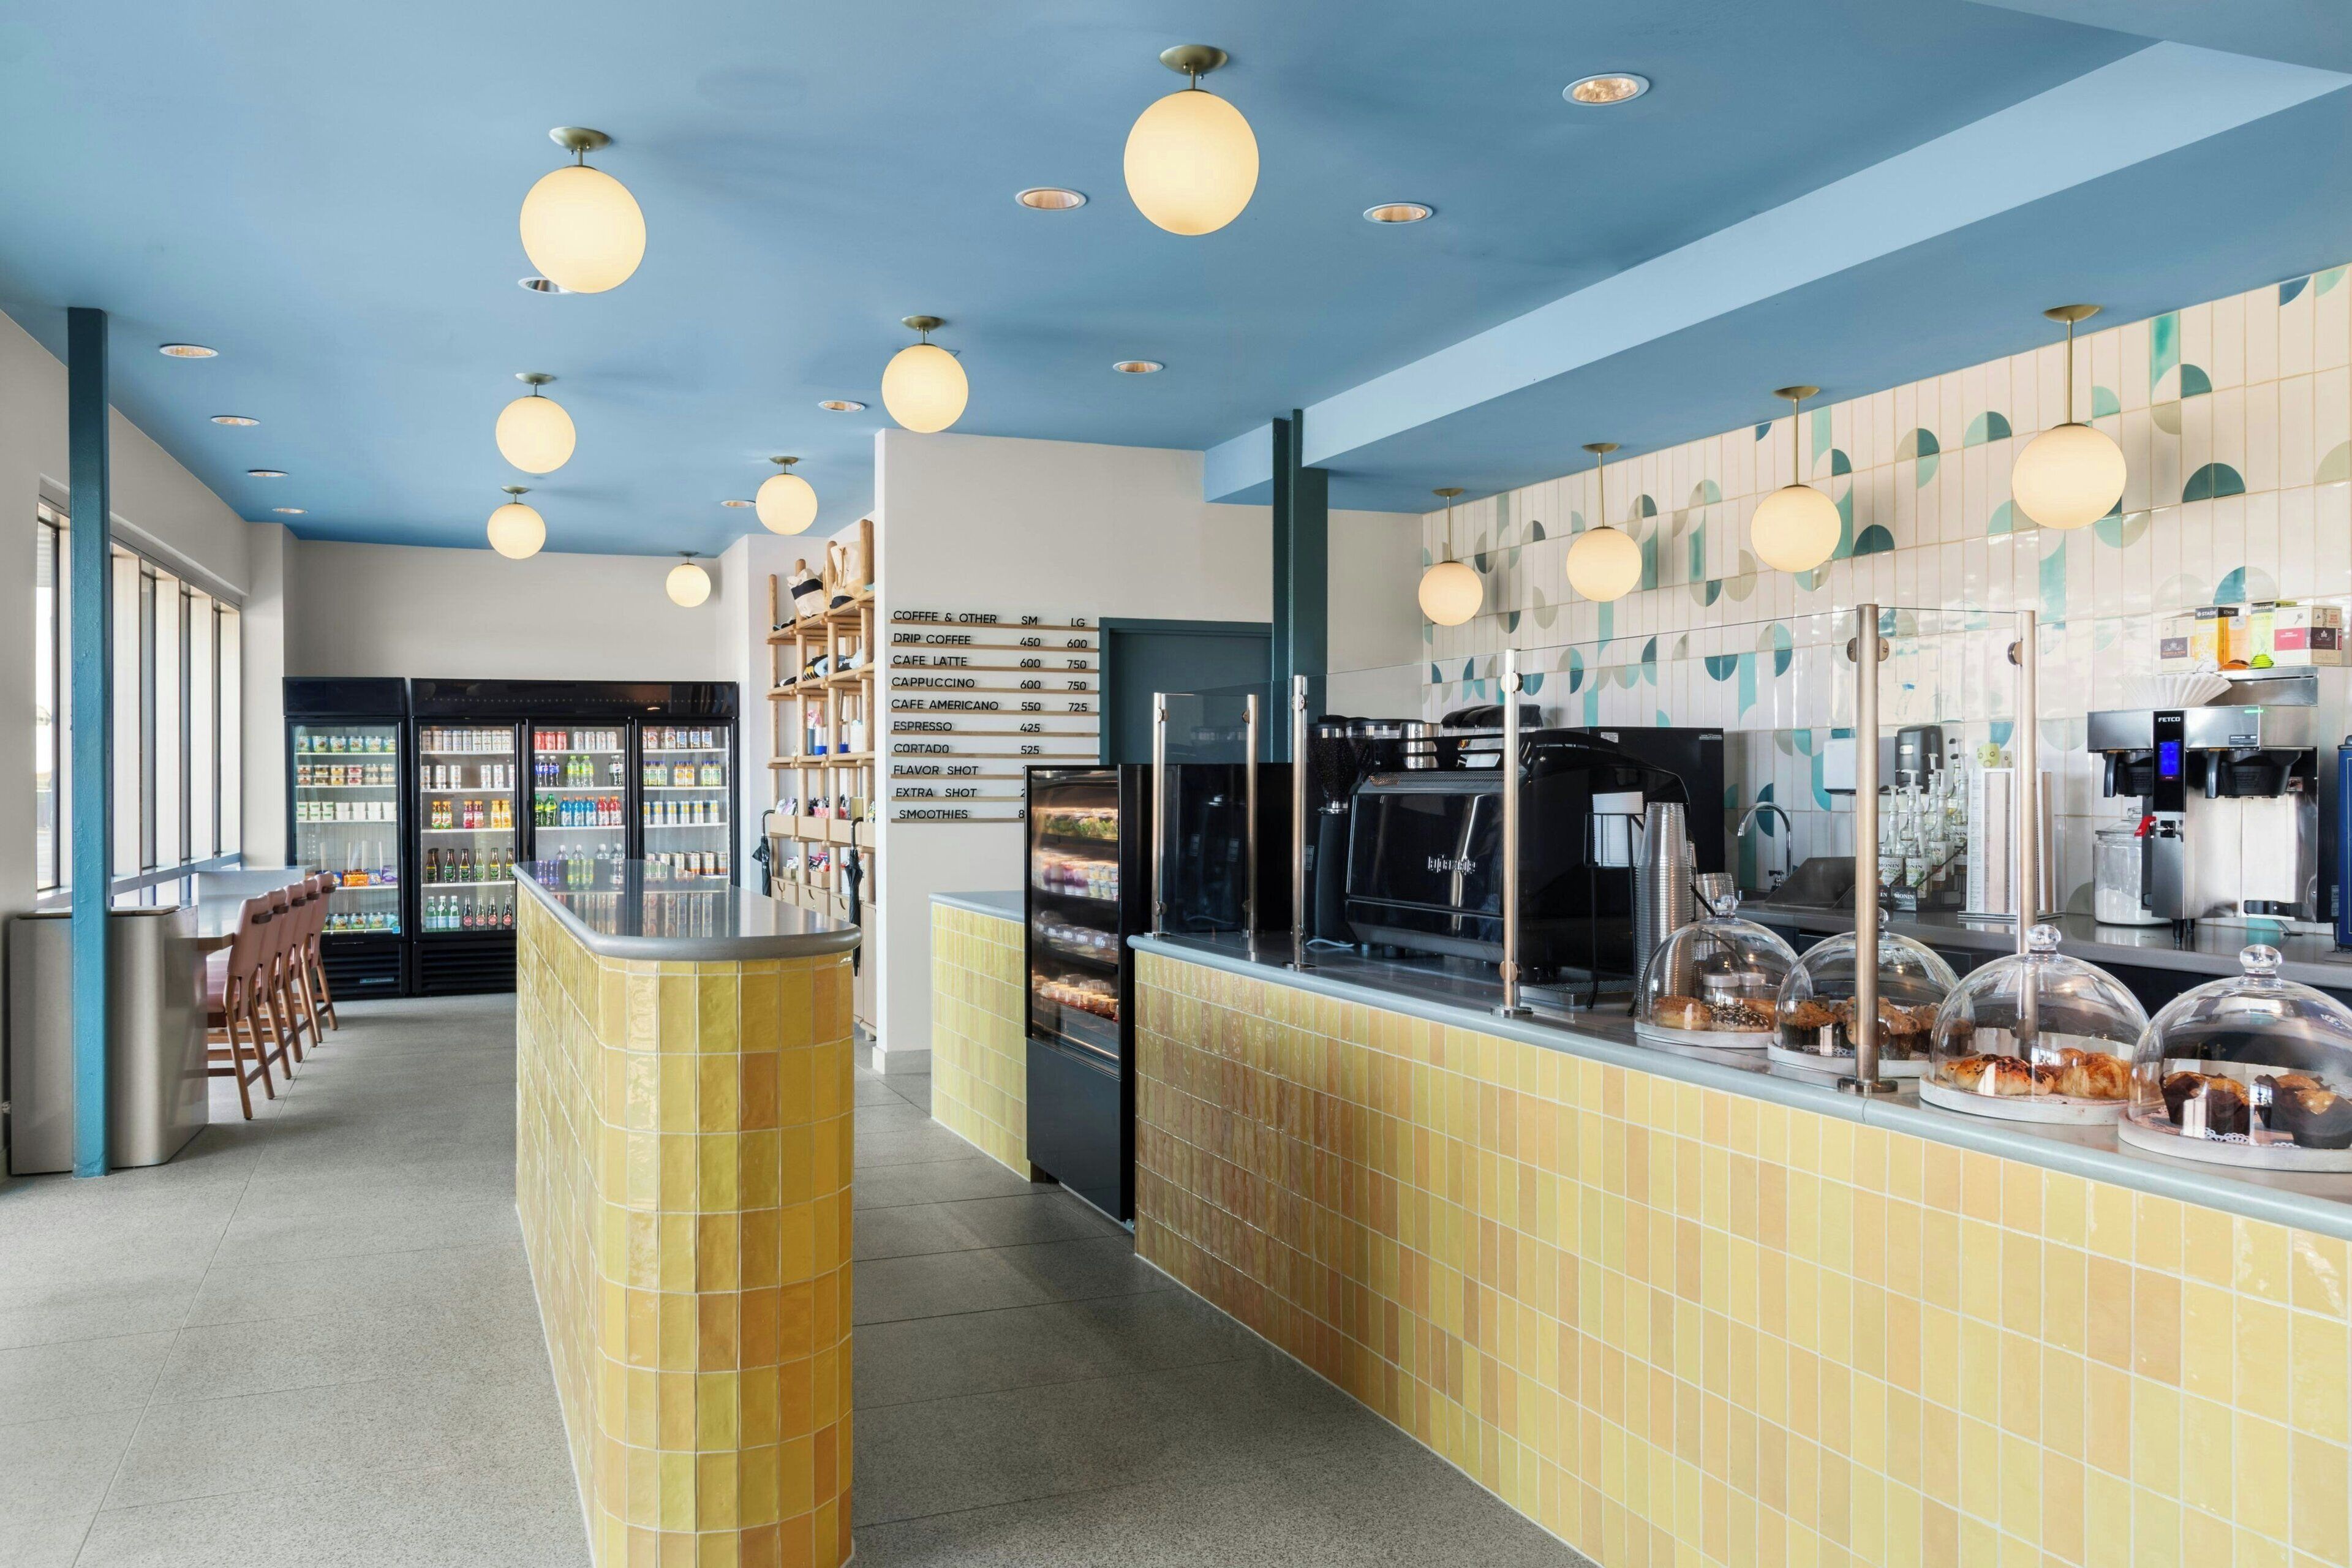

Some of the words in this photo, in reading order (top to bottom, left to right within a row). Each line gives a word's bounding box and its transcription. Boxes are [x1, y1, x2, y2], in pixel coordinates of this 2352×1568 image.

[893, 611, 938, 622] COFFFE
[944, 612, 952, 622] &
[959, 613, 997, 624] OTHER
[1021, 616, 1038, 625] SM
[1071, 618, 1085, 627] LG
[894, 633, 921, 643] DRIP
[926, 635, 971, 645] COFFEE
[1020, 637, 1041, 647] 450
[1067, 639, 1088, 649] 600
[893, 655, 925, 665] CAFE
[933, 656, 967, 666] LATTE
[1020, 658, 1041, 668] 600
[1067, 660, 1087, 669] 750
[892, 677, 975, 688] CAPPUCCINO
[1020, 680, 1041, 690] 600
[1068, 681, 1087, 690] 750
[891, 699, 924, 709] CAFE
[929, 700, 999, 710] AMERICANO
[1021, 702, 1041, 712] 550
[1068, 703, 1087, 712] 725
[894, 721, 952, 731] ESPRESSO
[1020, 723, 1040, 733] 425
[1020, 745, 1039, 755] 525
[894, 765, 940, 775] FLAVOR
[947, 766, 979, 775] SHOT
[895, 788, 933, 797] EXTRA
[945, 788, 977, 797] SHOT
[899, 810, 968, 820] SMOOTHIES
